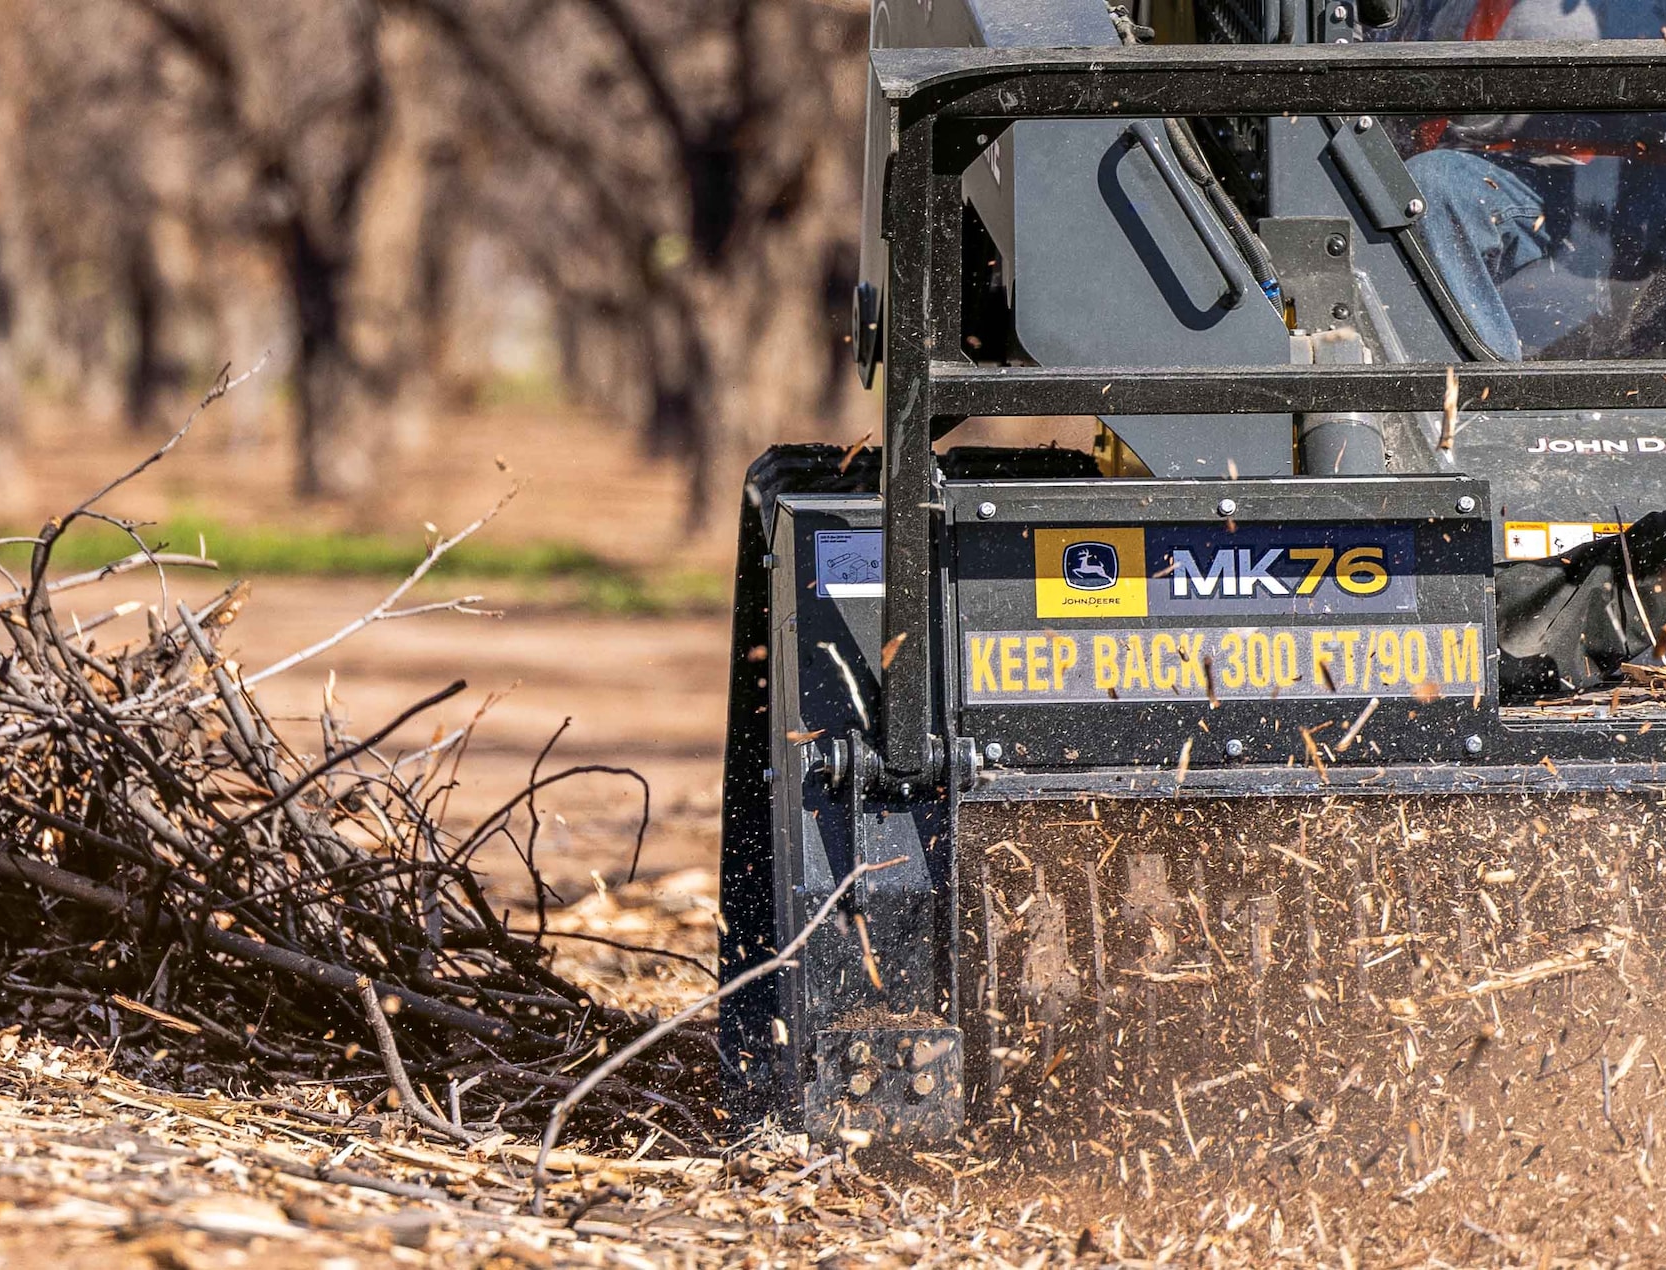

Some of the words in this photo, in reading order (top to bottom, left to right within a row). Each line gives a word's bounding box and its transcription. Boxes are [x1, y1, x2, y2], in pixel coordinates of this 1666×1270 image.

[1528, 437, 1629, 454] JOHN
[1171, 546, 1390, 597] MK76
[1061, 597, 1087, 605] JOHN
[1088, 596, 1121, 605] DEERE
[970, 635, 1077, 692] KEEP
[1093, 633, 1207, 690] BACK
[1221, 631, 1297, 689] 300
[1311, 629, 1428, 693] FT/90
[1441, 628, 1480, 684] M
